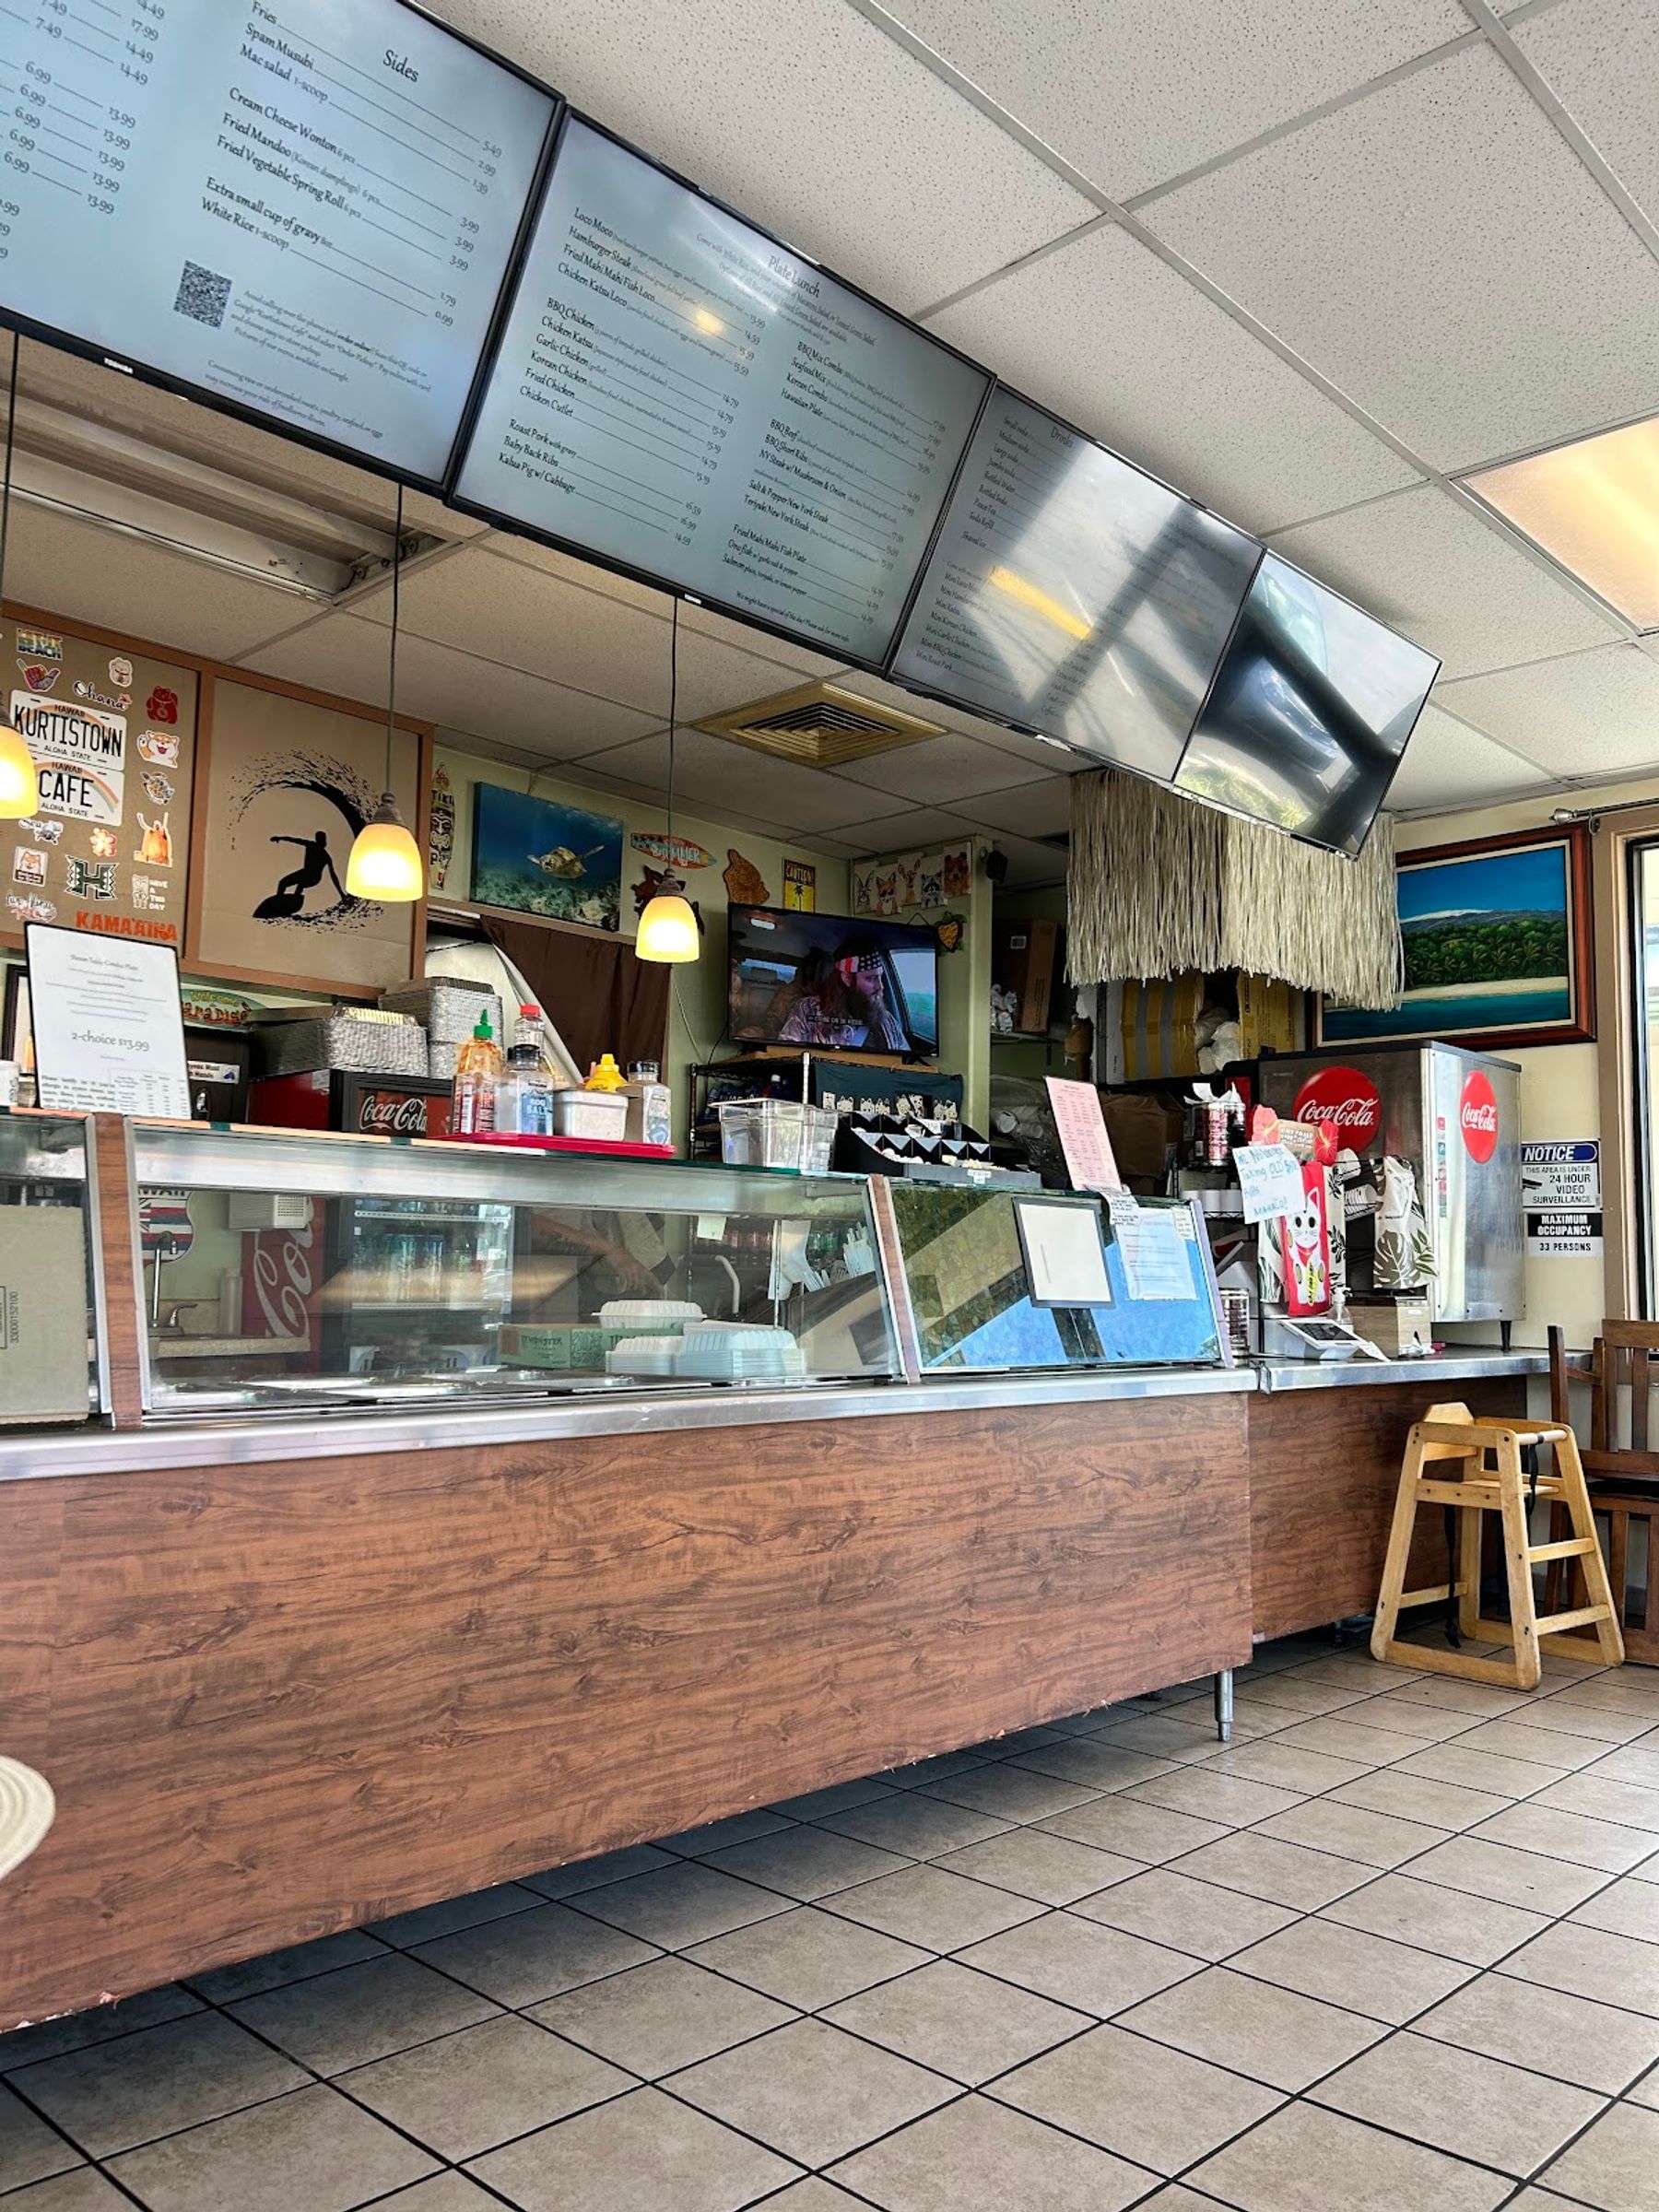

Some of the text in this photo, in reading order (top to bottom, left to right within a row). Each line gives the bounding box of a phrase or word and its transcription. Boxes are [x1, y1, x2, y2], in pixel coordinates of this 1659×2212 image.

[252, 0, 276, 24] Fries
[132, 18, 159, 41] 17.99
[36, 17, 147, 85] 7.49 14.49
[125, 41, 153, 63] 14.49
[382, 50, 418, 82] Sides
[240, 43, 263, 65] Mac
[264, 61, 291, 80] salad
[294, 77, 327, 103] 1-scoop
[25, 61, 135, 128] 6.99 13.99
[245, 22, 496, 177] Spam Musubi 2.99
[19, 84, 130, 149] 6.99 13.99
[15, 106, 124, 171] 6.99 13.99
[9, 128, 120, 192] 6.99 13.99
[229, 87, 263, 113] Cream
[264, 106, 298, 132] Cheese
[300, 124, 336, 153] Wonton
[460, 217, 479, 233] 3.99
[4, 151, 114, 214] 6.99 13.99
[223, 112, 251, 135] Fried
[250, 127, 290, 156] Mandoo
[454, 236, 474, 253] 3.99
[206, 176, 234, 199] Extra
[235, 194, 264, 213] small
[263, 208, 282, 224] cup
[282, 217, 297, 231] of
[292, 224, 320, 244] gravy
[217, 135, 245, 157] Fried
[246, 148, 290, 181] Vegetable
[291, 173, 324, 202] Spring
[324, 190, 345, 208] Roll
[449, 254, 468, 271] 3.99
[574, 206, 613, 237] Loco Moco
[202, 196, 453, 326] White Rice 1-scoop 0.99
[569, 226, 631, 268] Hamburger Steak
[558, 262, 627, 306] Chicken Katsu Loco
[563, 243, 654, 301] Fried Mahi Mahi Fish Loco
[768, 255, 819, 298] Plate Lunch
[547, 297, 594, 330] BBQ Chicken
[541, 315, 571, 337] Chicken
[572, 331, 593, 348] Katsu
[535, 333, 559, 351] Garlic
[559, 344, 588, 365] Chicken
[525, 367, 574, 398] Fried Chicken
[530, 349, 557, 371] Korean
[558, 363, 587, 384] Chicken
[519, 385, 573, 417] Chicken Cutlet
[509, 418, 531, 436] Roast
[531, 428, 548, 442] Pork
[503, 435, 558, 466] Baby Back Ribs
[499, 452, 520, 469] Kalua
[521, 461, 534, 477] Pig
[544, 472, 575, 494] Cabbage
[74, 680, 126, 712] Ohana
[14, 704, 123, 758] KURTISTOWN
[44, 746, 91, 761] ALOHA STATE
[39, 770, 94, 807] CAFE
[41, 803, 88, 818] ALOHA STATE
[71, 1030, 116, 1046] 2-choice
[359, 1095, 427, 1132] Coca-Cola
[1297, 1097, 1379, 1127] Coca-Cola
[1461, 1100, 1496, 1133] Coca-Cola
[1524, 1146, 1575, 1161] NOTICE
[1541, 1165, 1559, 1173] AREA
[1567, 1165, 1591, 1173] UNDER
[1549, 1173, 1591, 1183] 24 HOUR
[1556, 1184, 1585, 1194] VIDEO
[1533, 1195, 1592, 1205] SURVEILLANCE
[1536, 1225, 1592, 1236] OCCUPANCY
[1541, 1215, 1588, 1225] MAXIMUM
[1539, 1242, 1592, 1252] 33 PERSONS
